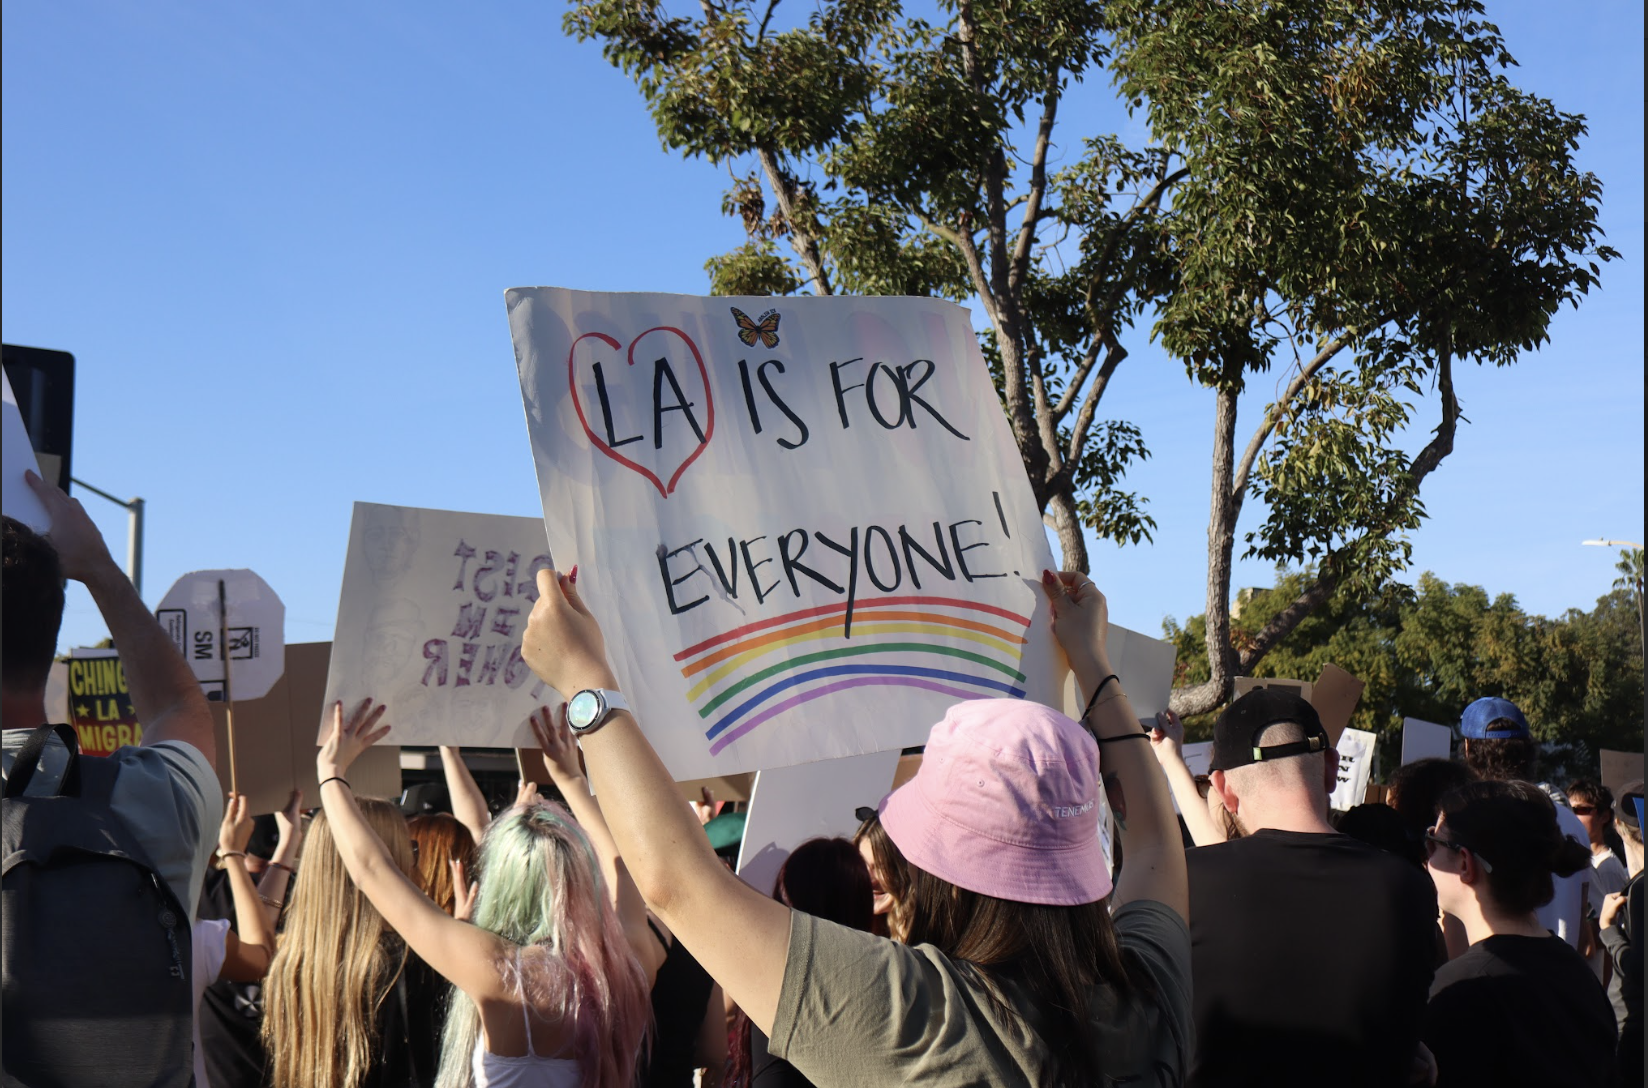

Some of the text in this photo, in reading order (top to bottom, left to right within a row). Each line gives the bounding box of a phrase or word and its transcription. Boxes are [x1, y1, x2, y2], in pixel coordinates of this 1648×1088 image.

[592, 356, 971, 450] LA IS FOR
[656, 491, 1021, 640] EVERYONE!
[194, 631, 213, 660] SM
[96, 698, 121, 721] LA
